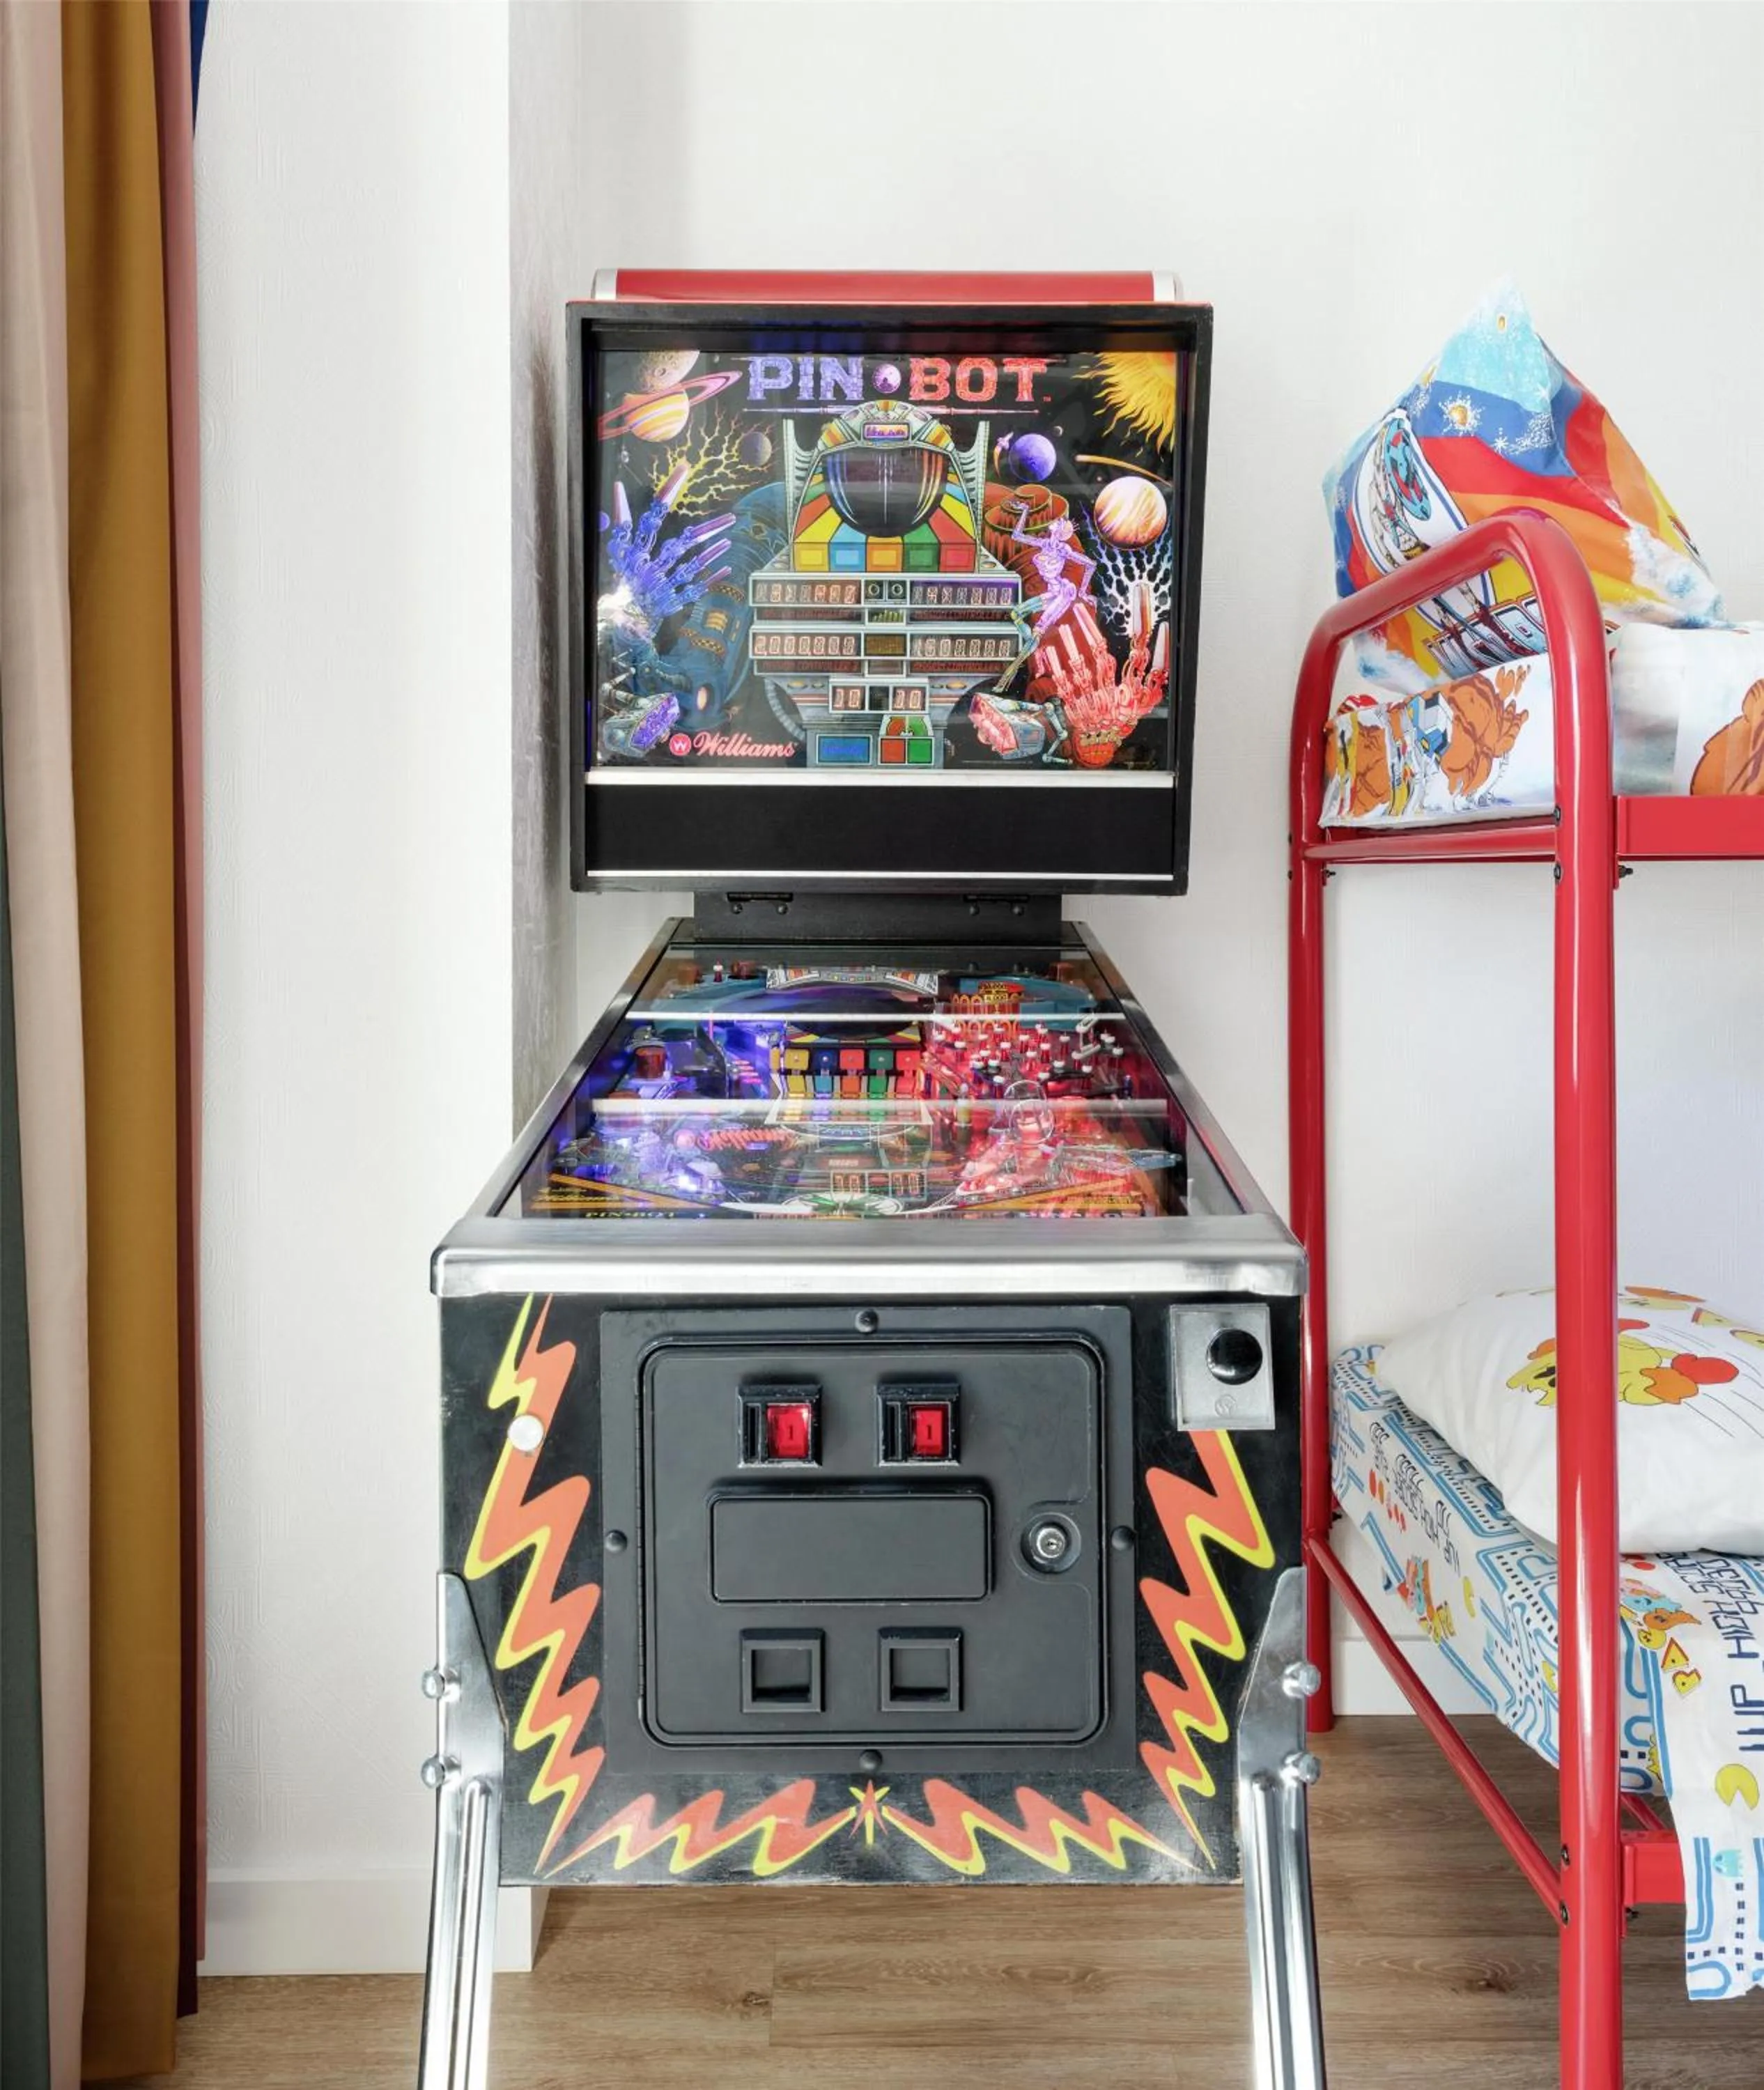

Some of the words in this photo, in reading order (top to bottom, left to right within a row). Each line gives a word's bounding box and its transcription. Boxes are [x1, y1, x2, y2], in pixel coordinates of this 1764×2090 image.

[747, 357, 865, 401] PIN
[908, 357, 1046, 402] BOT
[693, 731, 795, 757] Williams
[1702, 1600, 1759, 1658] HIGH
